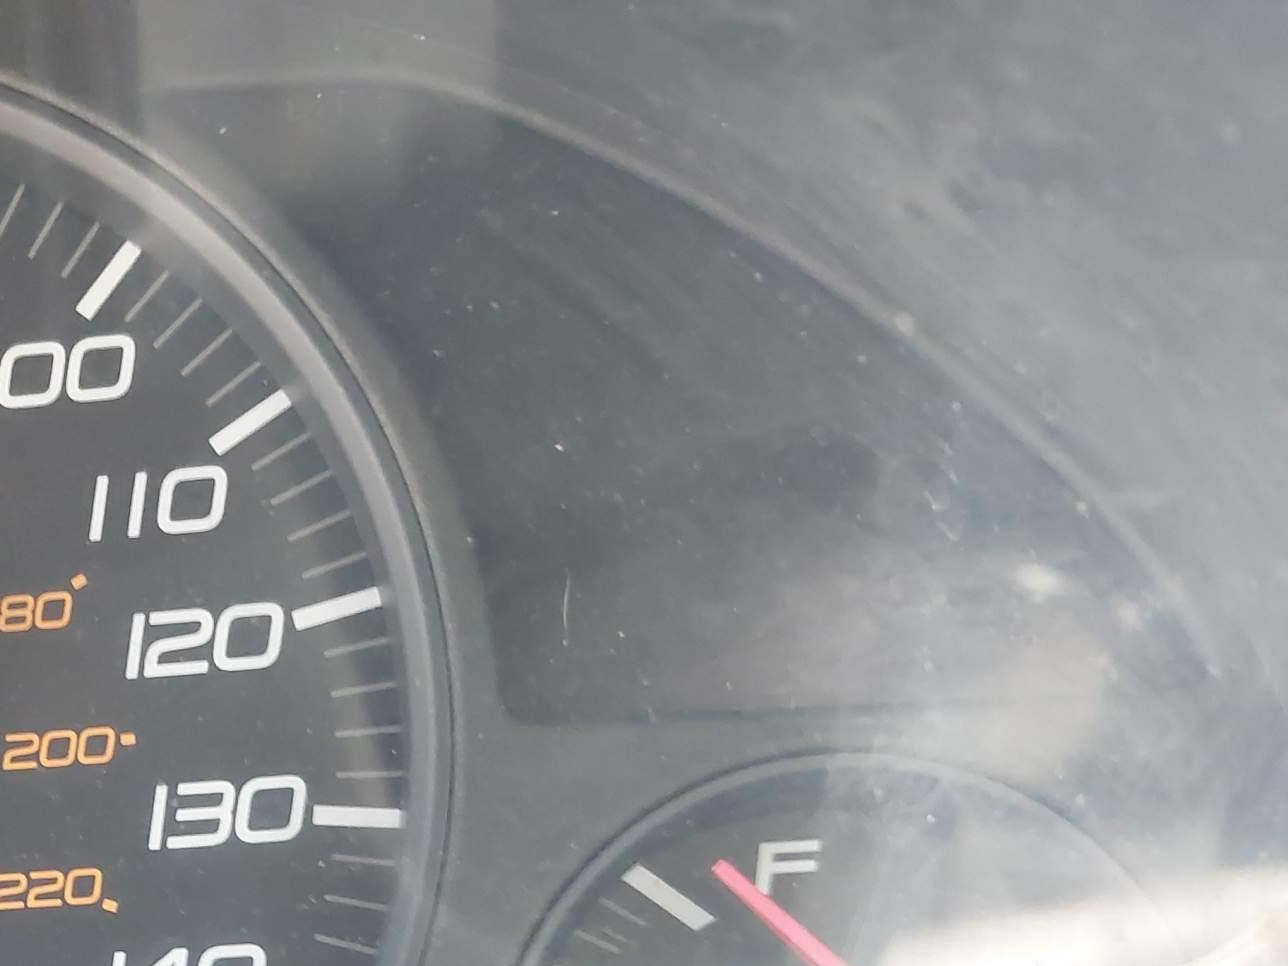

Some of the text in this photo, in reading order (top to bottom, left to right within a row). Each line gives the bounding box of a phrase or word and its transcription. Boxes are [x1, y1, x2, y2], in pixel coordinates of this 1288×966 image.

[89, 466, 227, 541] 110
[126, 603, 284, 679] 120
[3, 727, 115, 770] 200
[149, 775, 306, 850] 130
[755, 840, 821, 896] F
